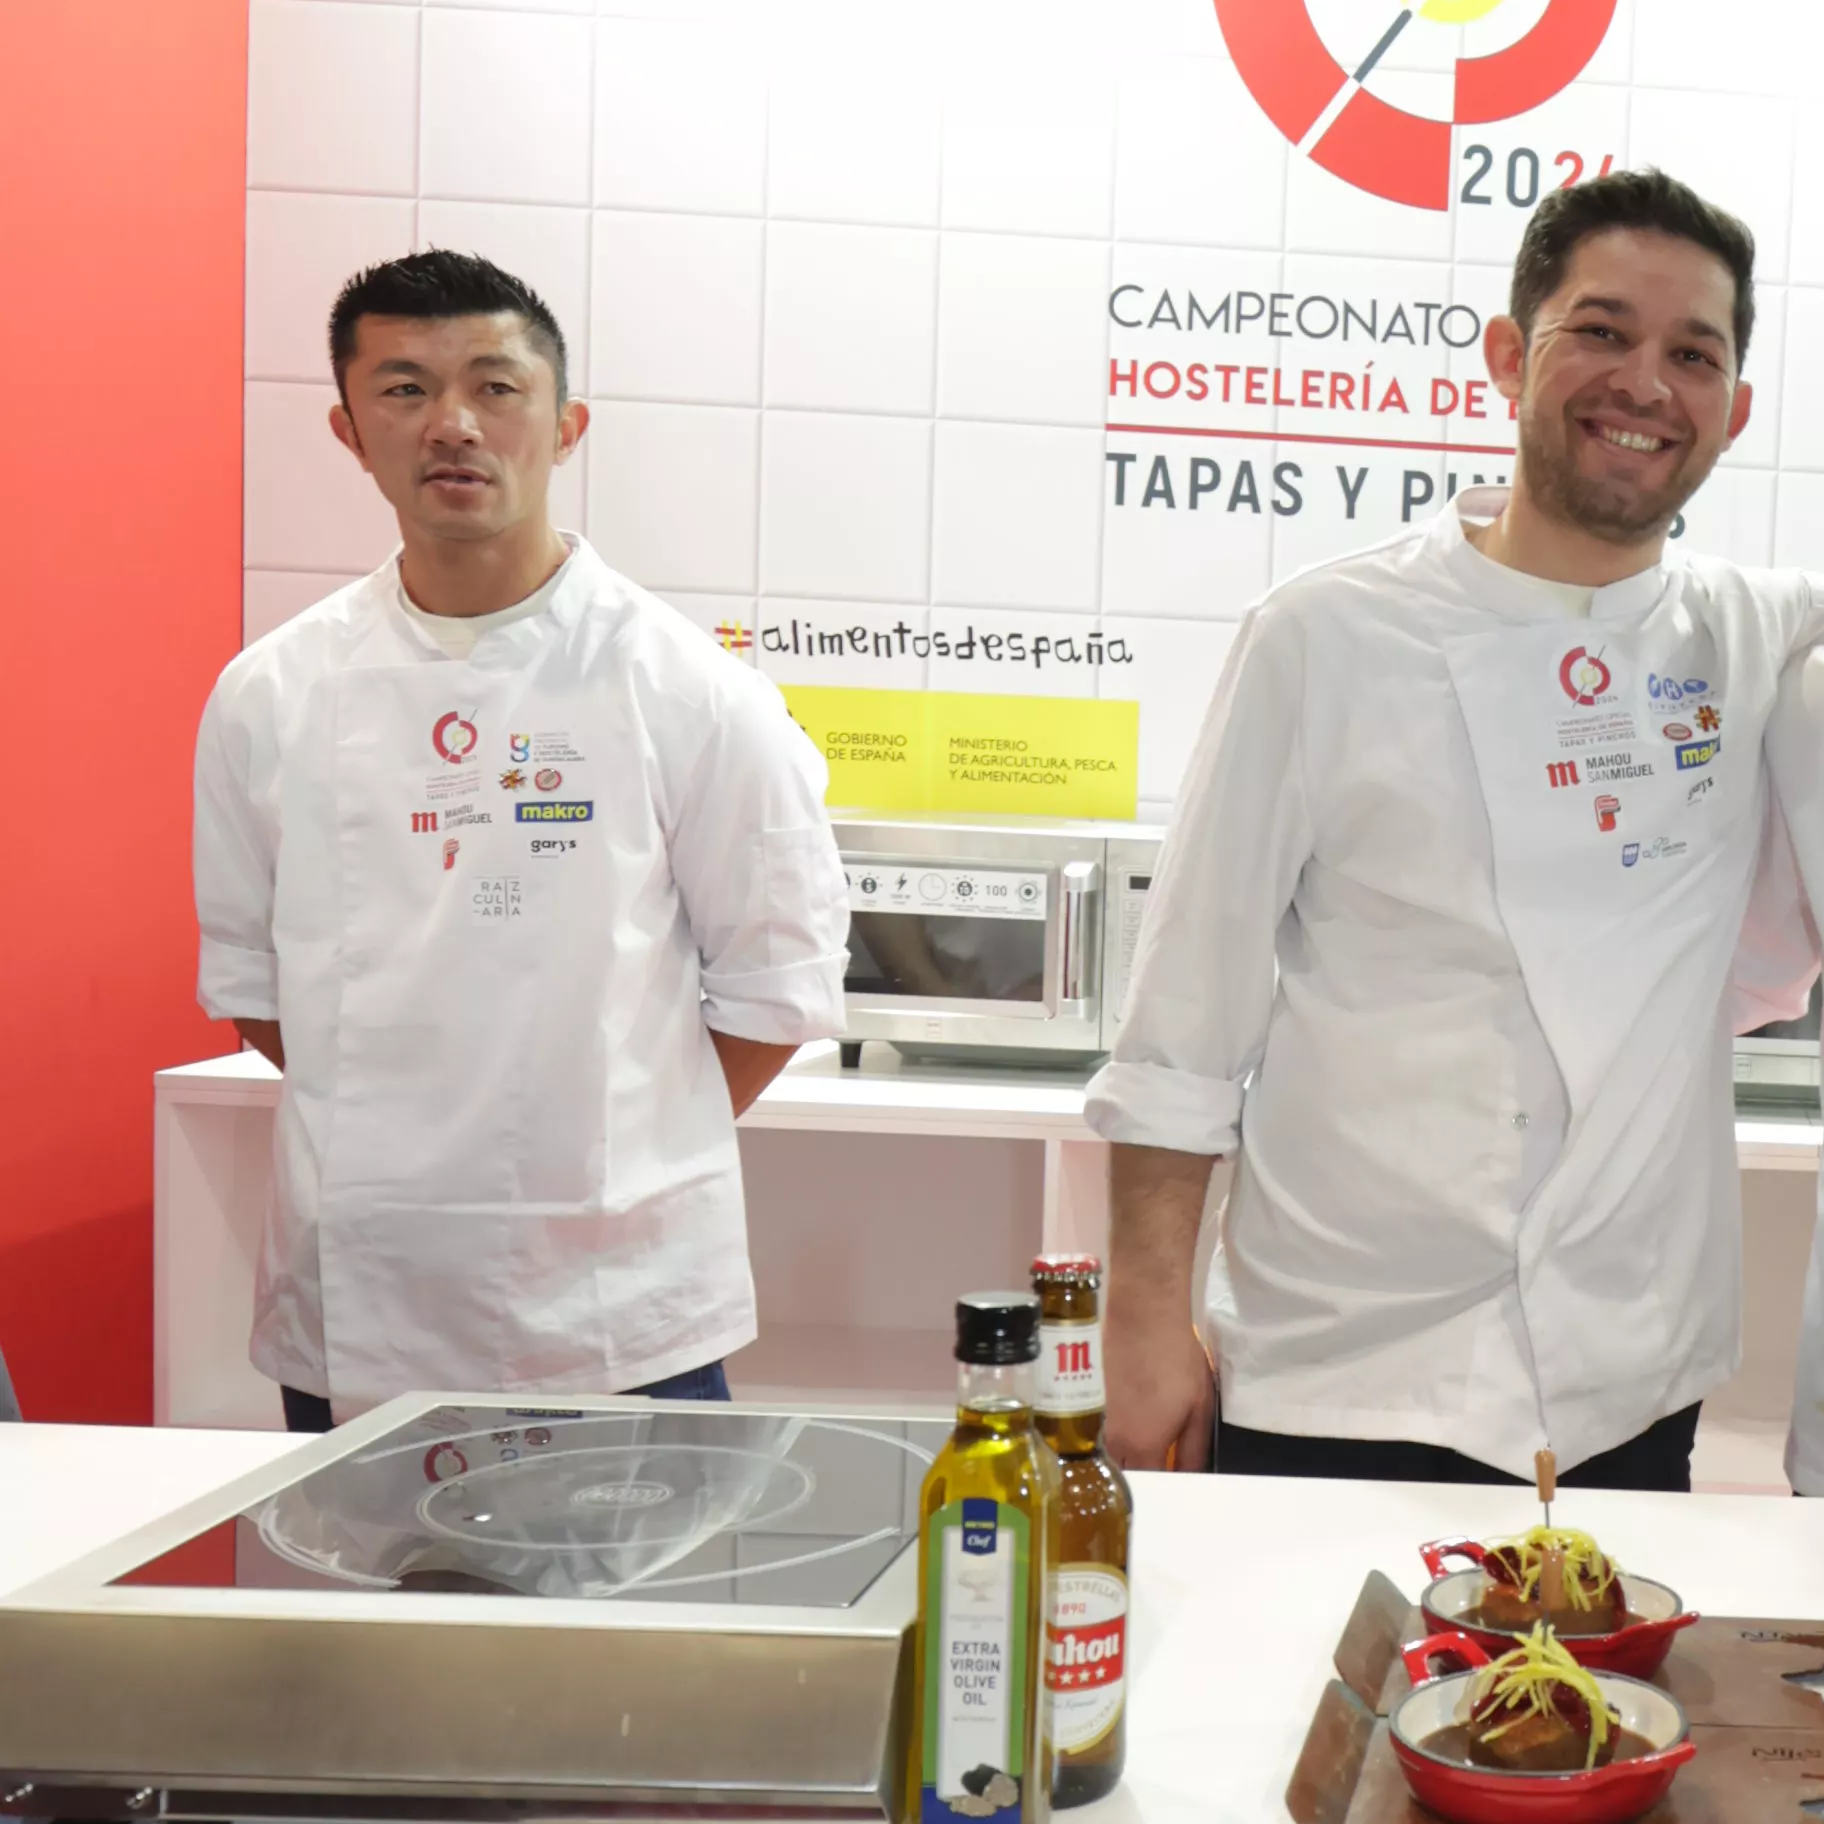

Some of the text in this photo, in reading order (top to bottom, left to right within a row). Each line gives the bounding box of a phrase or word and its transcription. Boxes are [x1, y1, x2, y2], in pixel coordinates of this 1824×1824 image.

[1460, 143, 1614, 208] 202
[1108, 283, 1481, 349] CAMPEONATO
[1108, 357, 1488, 419] HOSTELERÍA DE
[1106, 451, 1303, 517] TAPAS
[1336, 465, 1370, 520] Y
[714, 619, 1133, 669] #alimentosdespaña
[825, 731, 908, 748] GOBIERNO
[949, 736, 1029, 753] MINISTERIO
[825, 746, 907, 763] DE ESPAÑA
[948, 753, 967, 767] DE
[1074, 758, 1117, 772] PESCA
[1585, 752, 1633, 771] MAHOU
[948, 768, 1067, 786] Y ALIMENTACIÓN
[1587, 762, 1656, 785] SANMIGUEL
[520, 802, 589, 821] makro
[985, 884, 1008, 897] 100
[951, 1641, 1000, 1656] EXTRA
[950, 1658, 1001, 1673] VIRGIN
[953, 1675, 997, 1689] OLIVE
[962, 1691, 987, 1706] OIL
